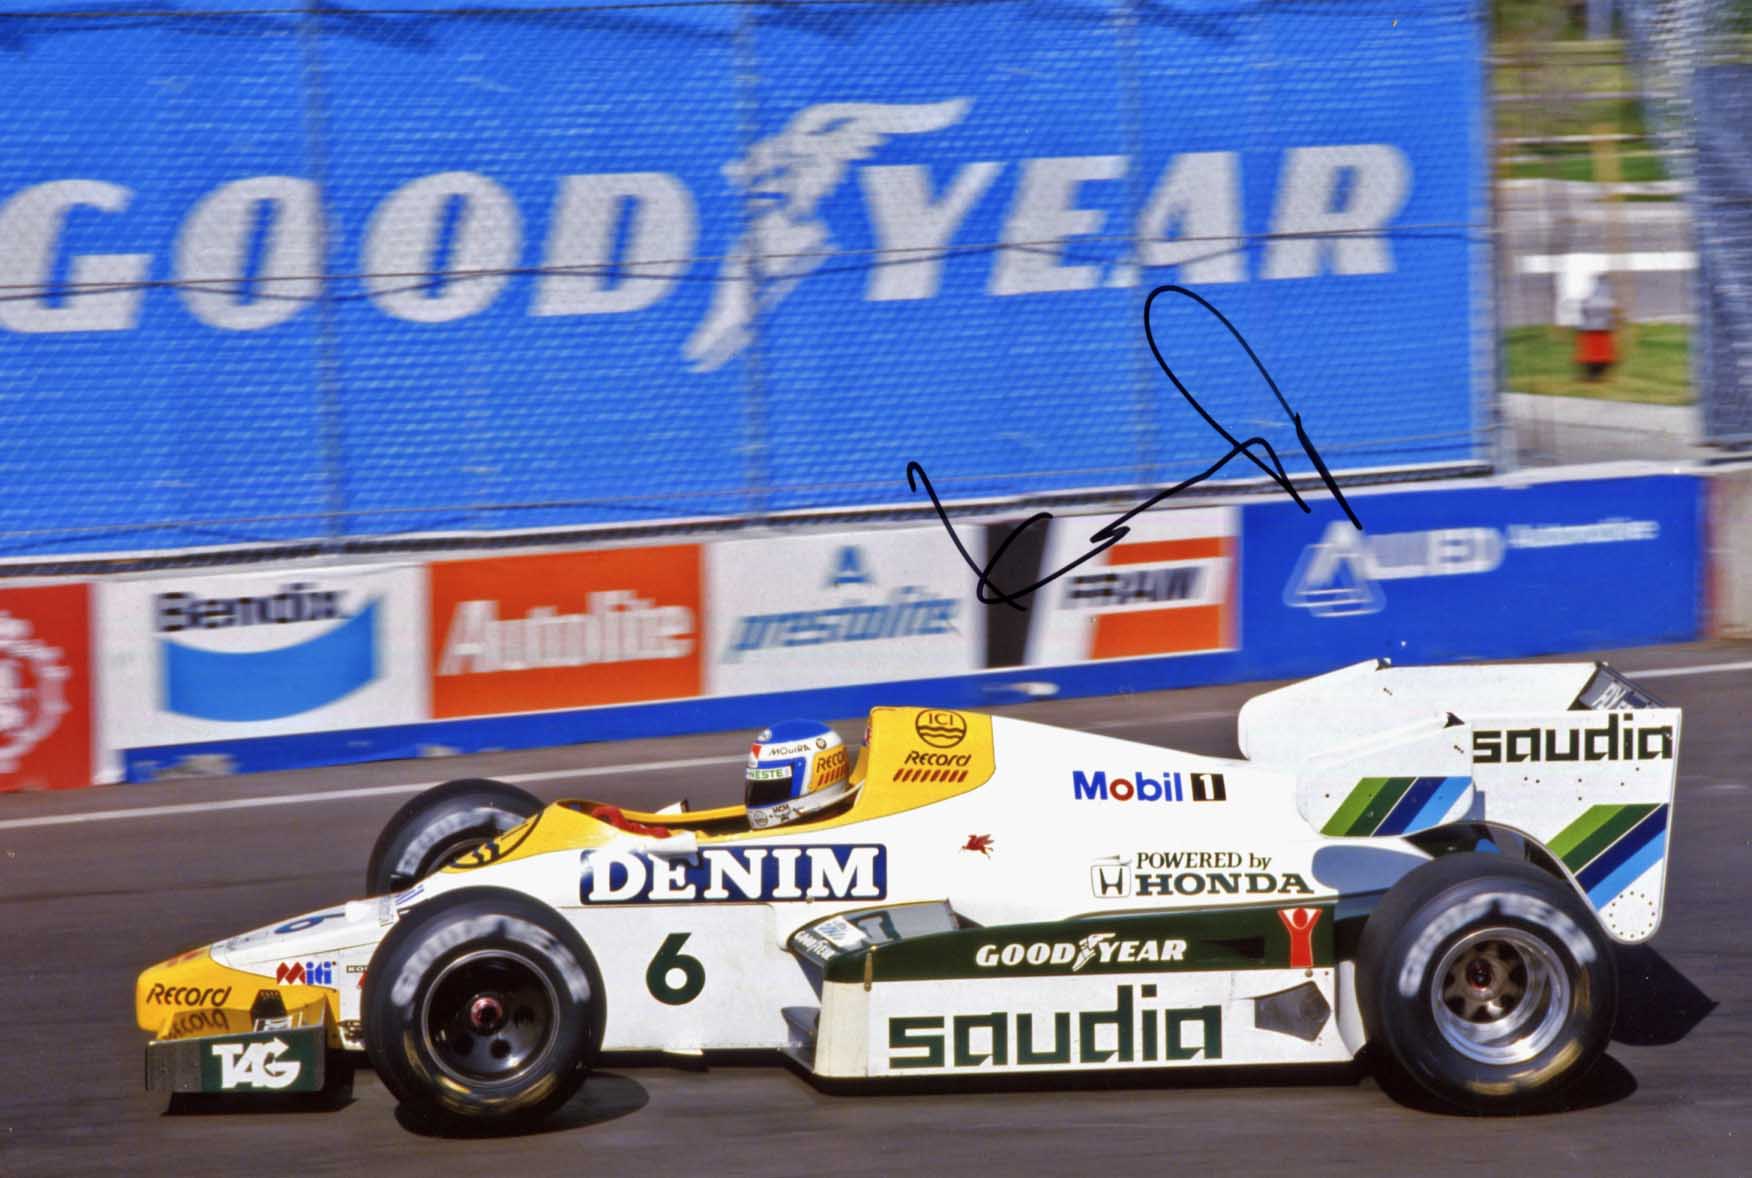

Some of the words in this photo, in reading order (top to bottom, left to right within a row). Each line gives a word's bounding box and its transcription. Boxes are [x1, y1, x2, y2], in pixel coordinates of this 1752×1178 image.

[155, 581, 347, 633] Bendix
[440, 589, 695, 676] Autolite
[928, 711, 955, 727] ICI
[1473, 713, 1673, 763] saudia
[1073, 770, 1183, 802] Mobil
[588, 846, 880, 901] DENIM
[1135, 872, 1315, 896] HONDA
[1137, 851, 1242, 870] POWERED
[1249, 852, 1272, 871] by
[647, 932, 706, 1006] 6
[889, 984, 1223, 1069] saudia
[211, 1037, 301, 1090] TAG
